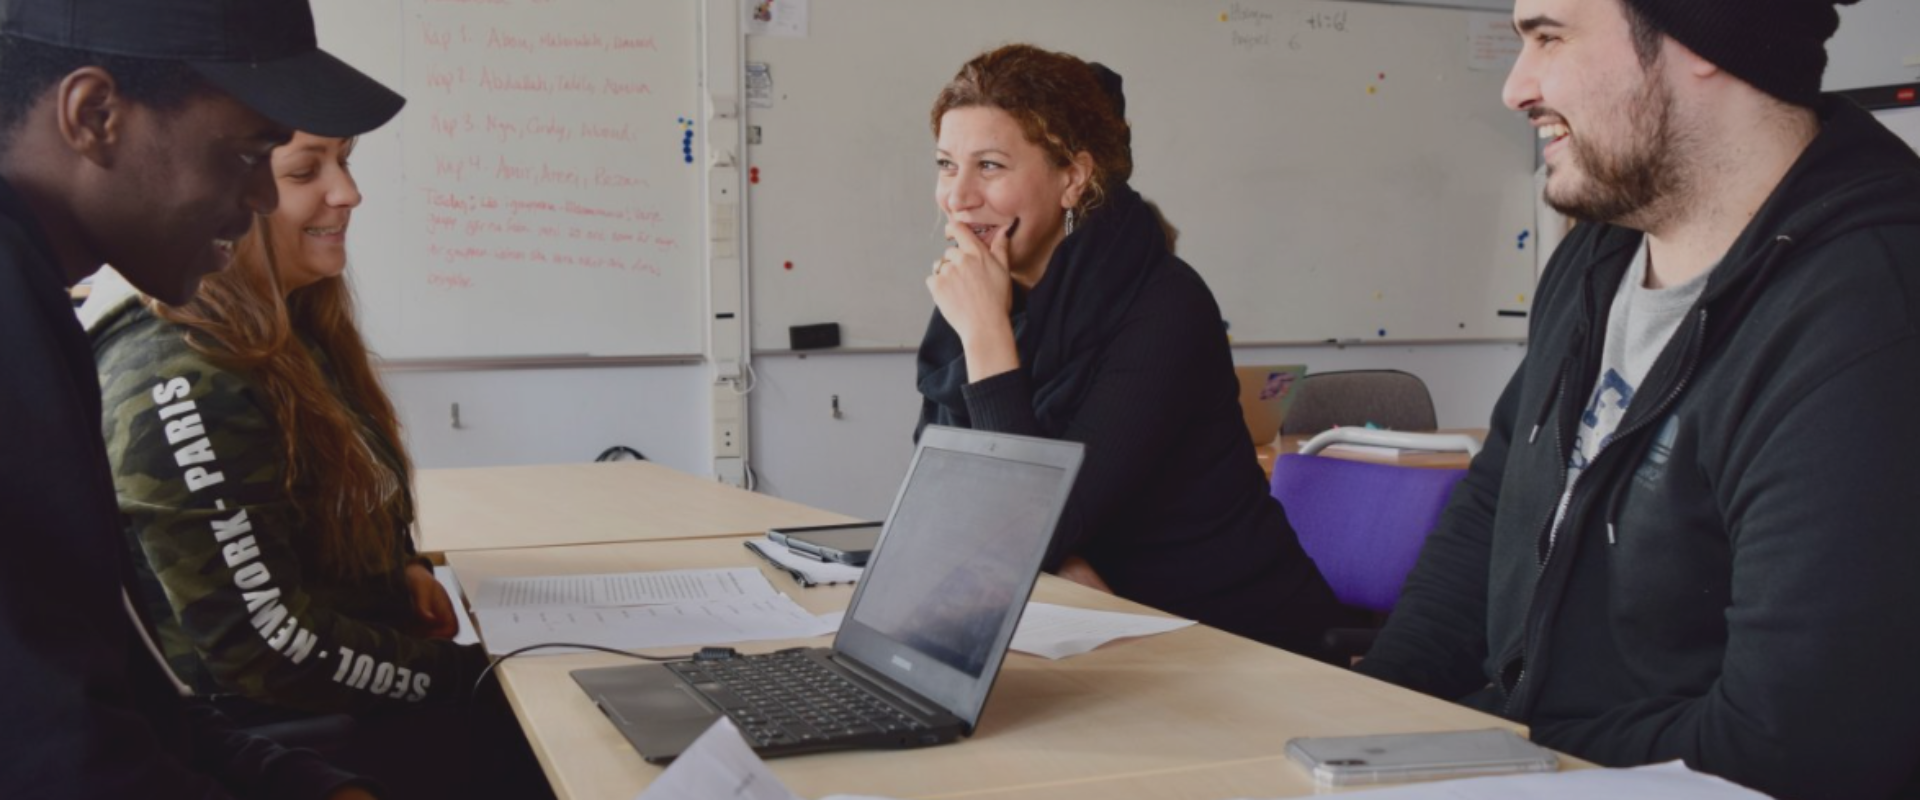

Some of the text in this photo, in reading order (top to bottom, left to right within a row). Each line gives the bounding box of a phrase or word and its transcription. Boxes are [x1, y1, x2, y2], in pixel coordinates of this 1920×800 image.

[153, 376, 225, 492] PARIS
[210, 508, 318, 664] NEWYORK
[332, 645, 431, 702] SEOUL
